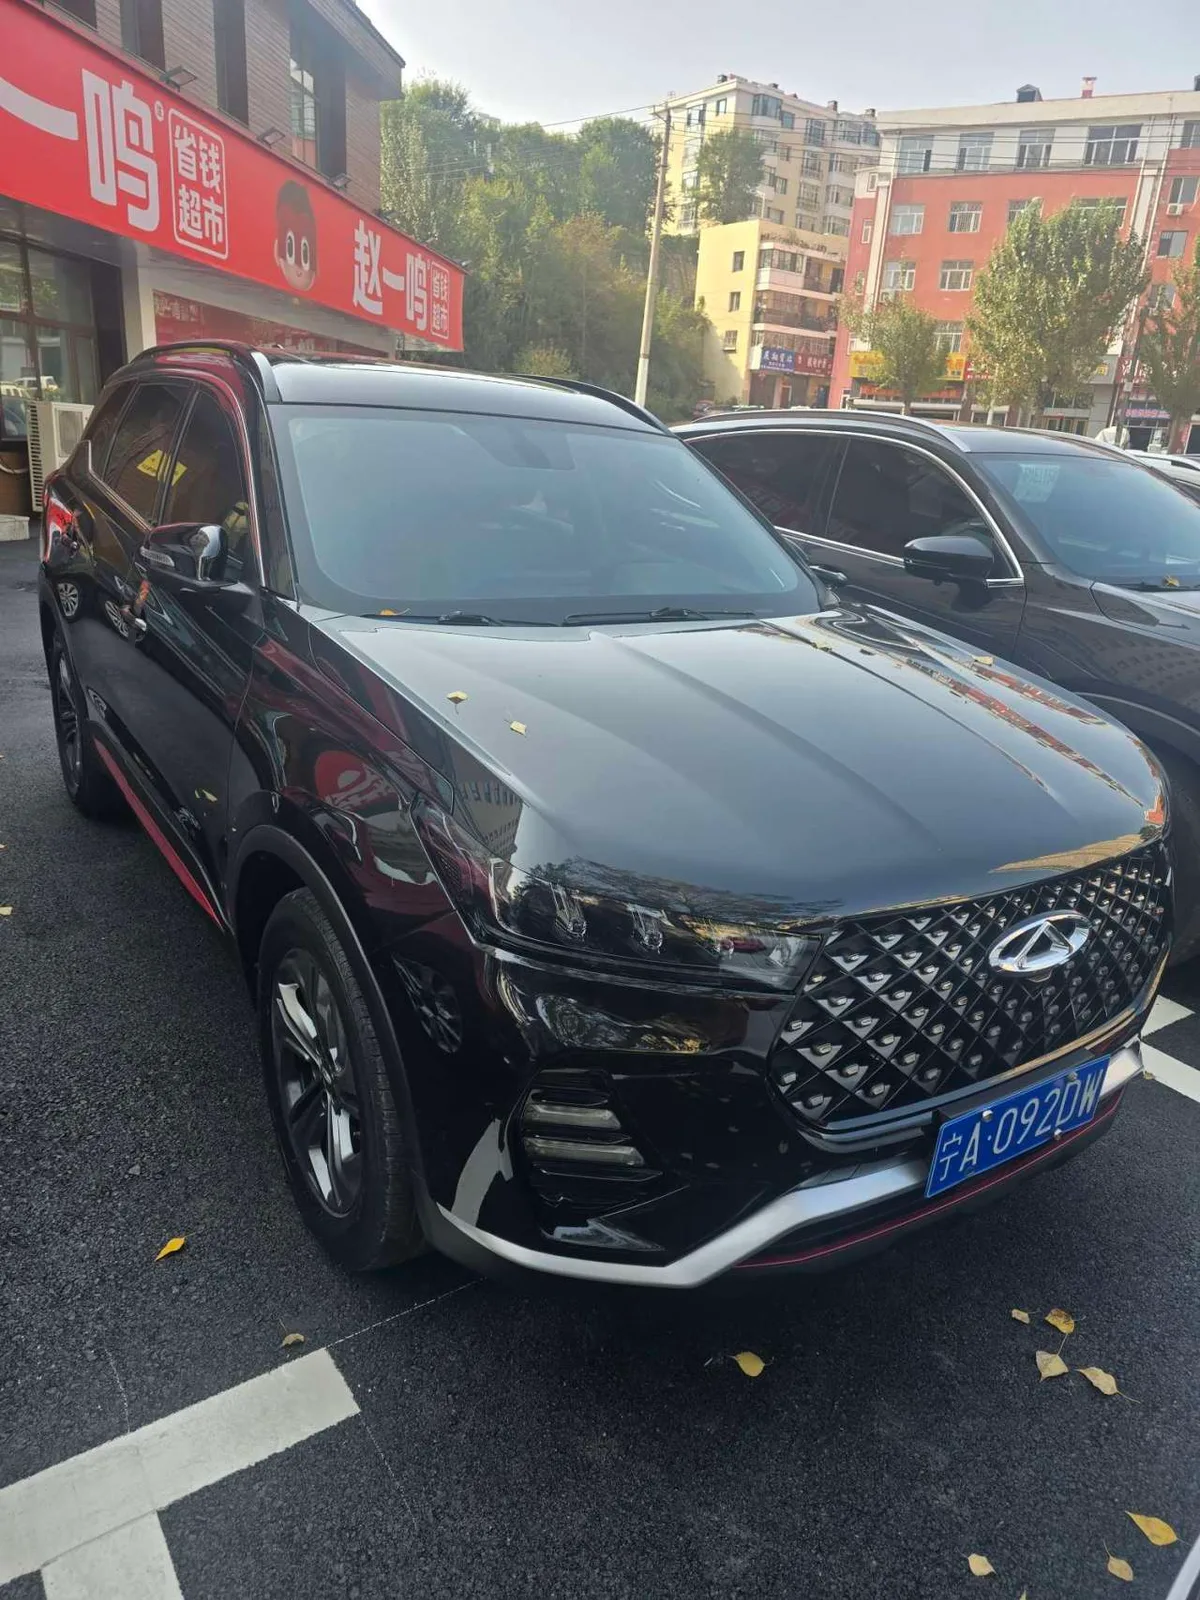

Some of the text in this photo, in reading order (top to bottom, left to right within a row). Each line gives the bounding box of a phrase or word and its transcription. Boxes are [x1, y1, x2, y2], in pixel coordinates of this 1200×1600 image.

[174, 125, 222, 194] 省钱
[178, 184, 224, 245] 超市
[353, 219, 428, 331] 赵一鸣
